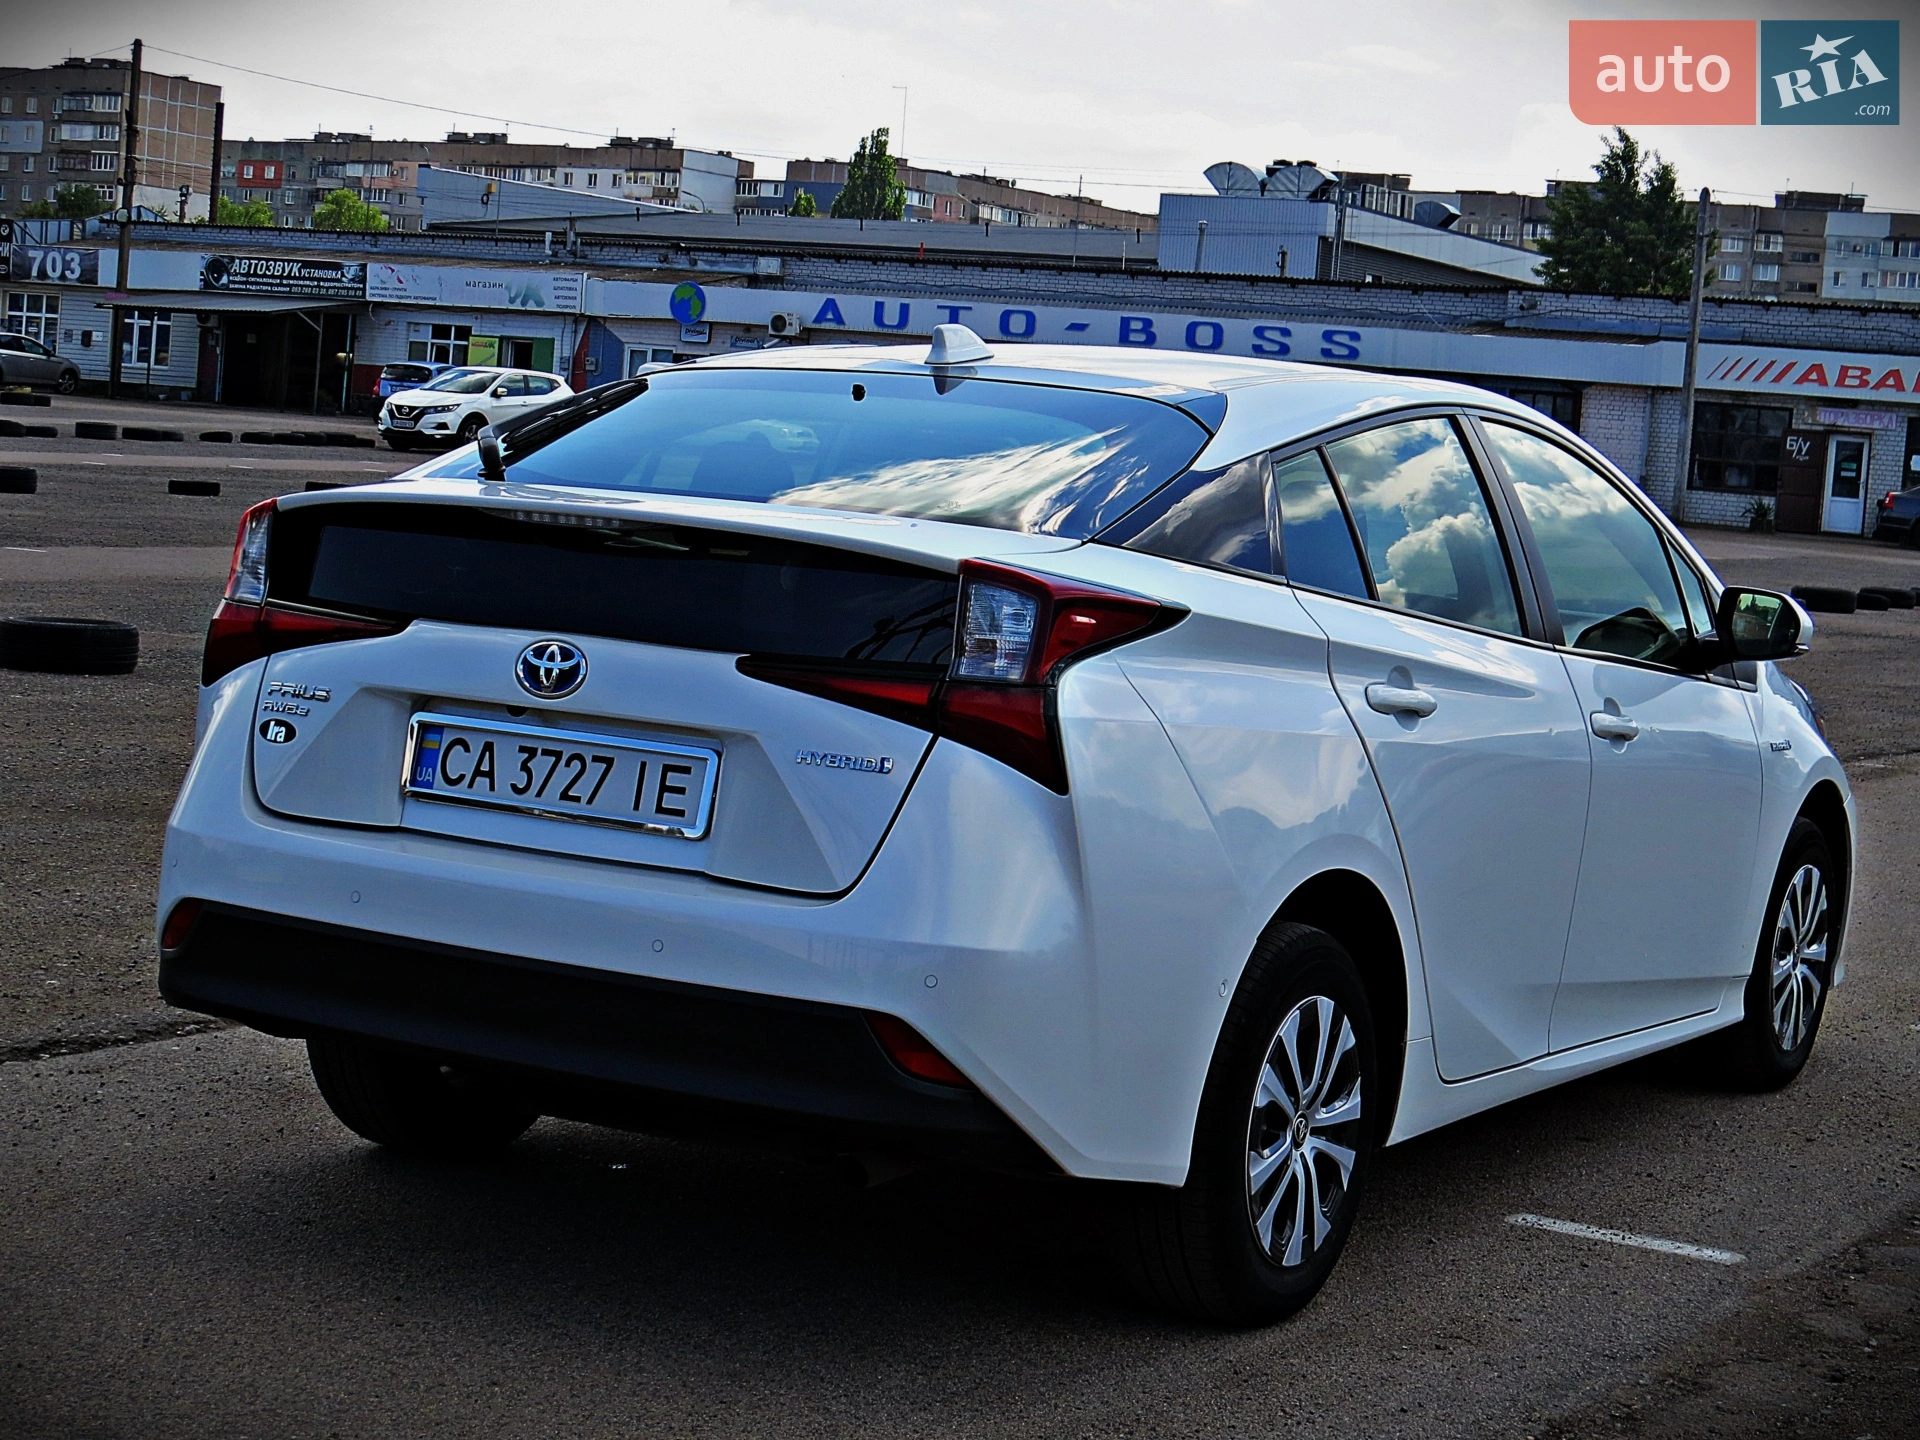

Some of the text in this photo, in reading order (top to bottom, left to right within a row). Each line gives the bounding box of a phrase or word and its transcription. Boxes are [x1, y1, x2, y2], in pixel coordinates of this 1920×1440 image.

[28, 250, 82, 280] 703
[231, 258, 341, 280] АВТОЗВУК УСТАНОВКА
[465, 280, 504, 289] магазин
[1792, 362, 1920, 394] АВА
[267, 682, 331, 702] PRIUS
[266, 720, 286, 742] Ira
[796, 750, 877, 772] HYBRID
[415, 765, 433, 783] UA
[509, 744, 615, 806] 3727
